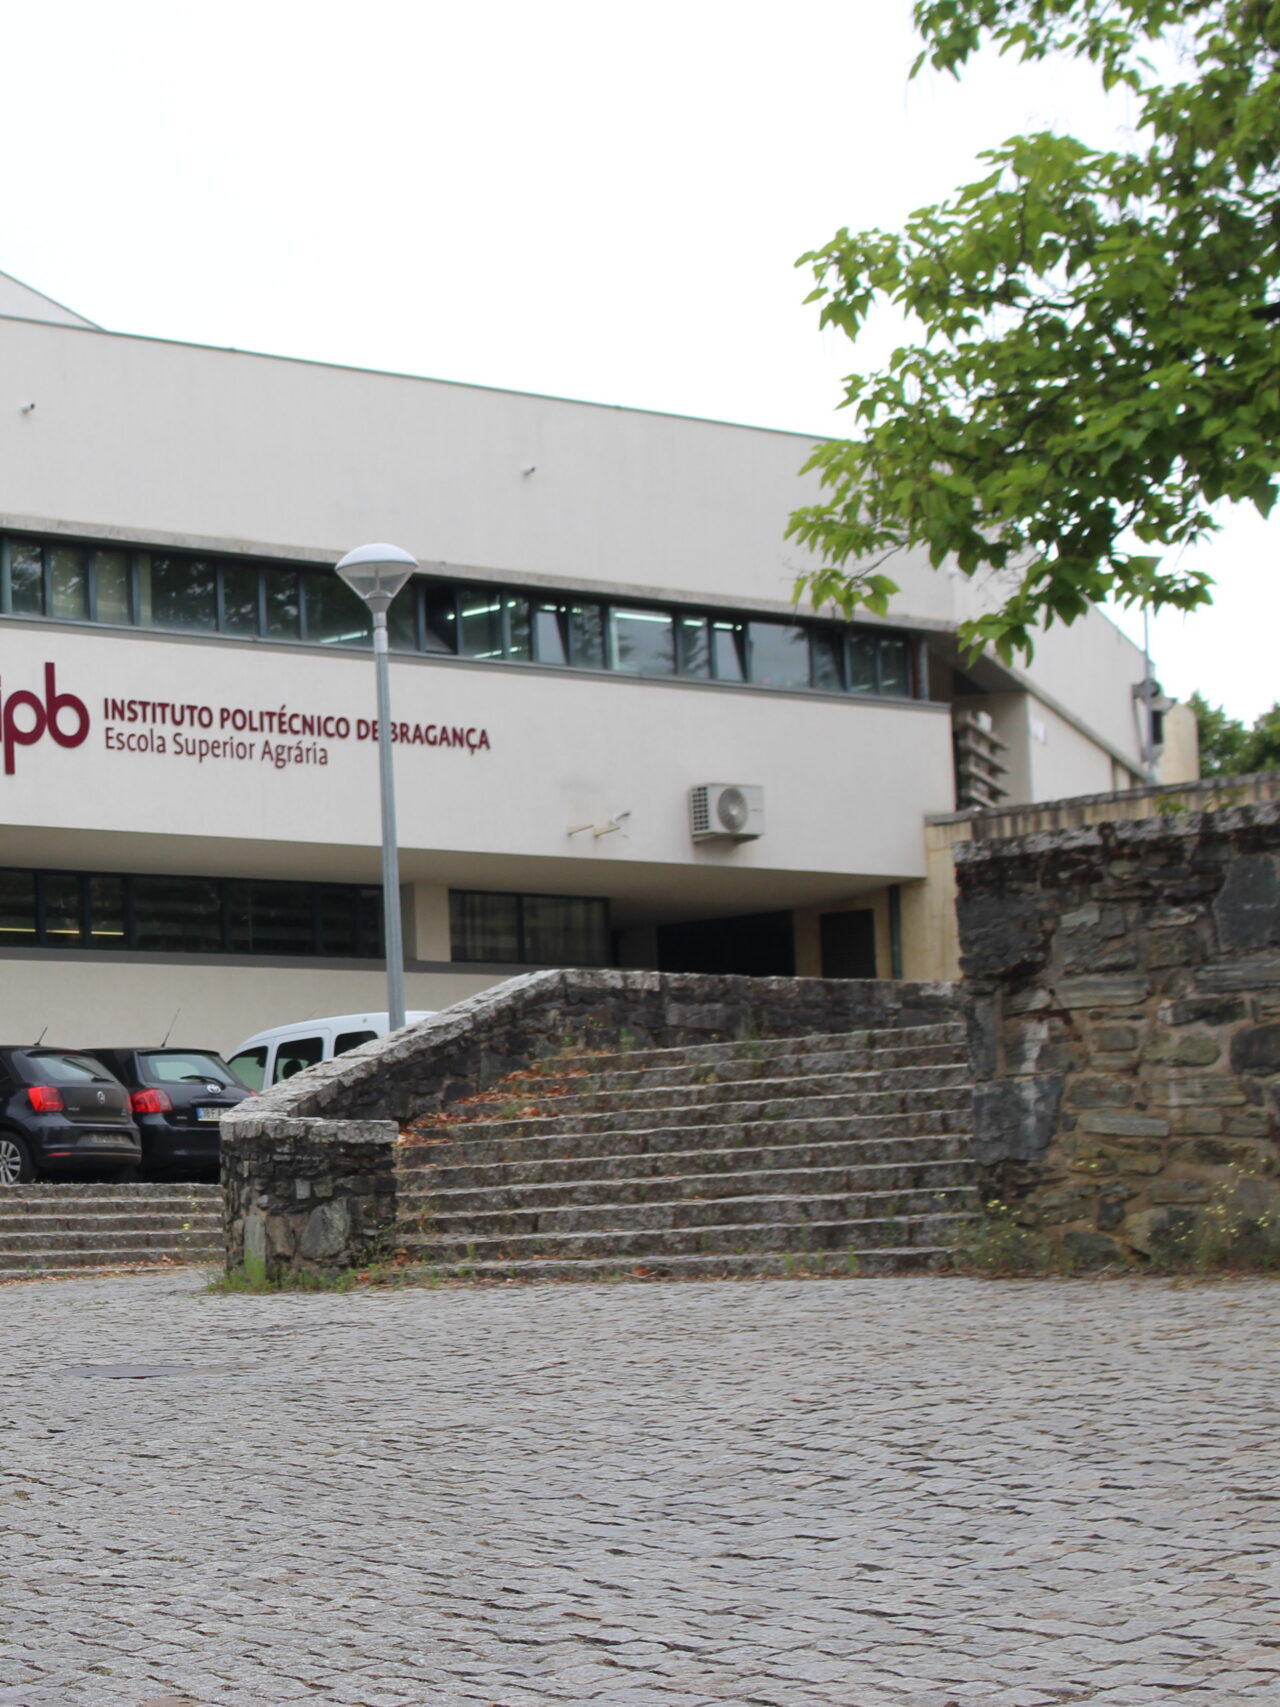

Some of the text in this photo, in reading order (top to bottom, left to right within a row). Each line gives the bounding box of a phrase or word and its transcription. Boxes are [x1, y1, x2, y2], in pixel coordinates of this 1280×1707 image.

[103, 697, 491, 757] INSTITUTO POLITÉCNICO DE BRAGANÇA
[105, 727, 329, 770] Escola Superior Agrária
